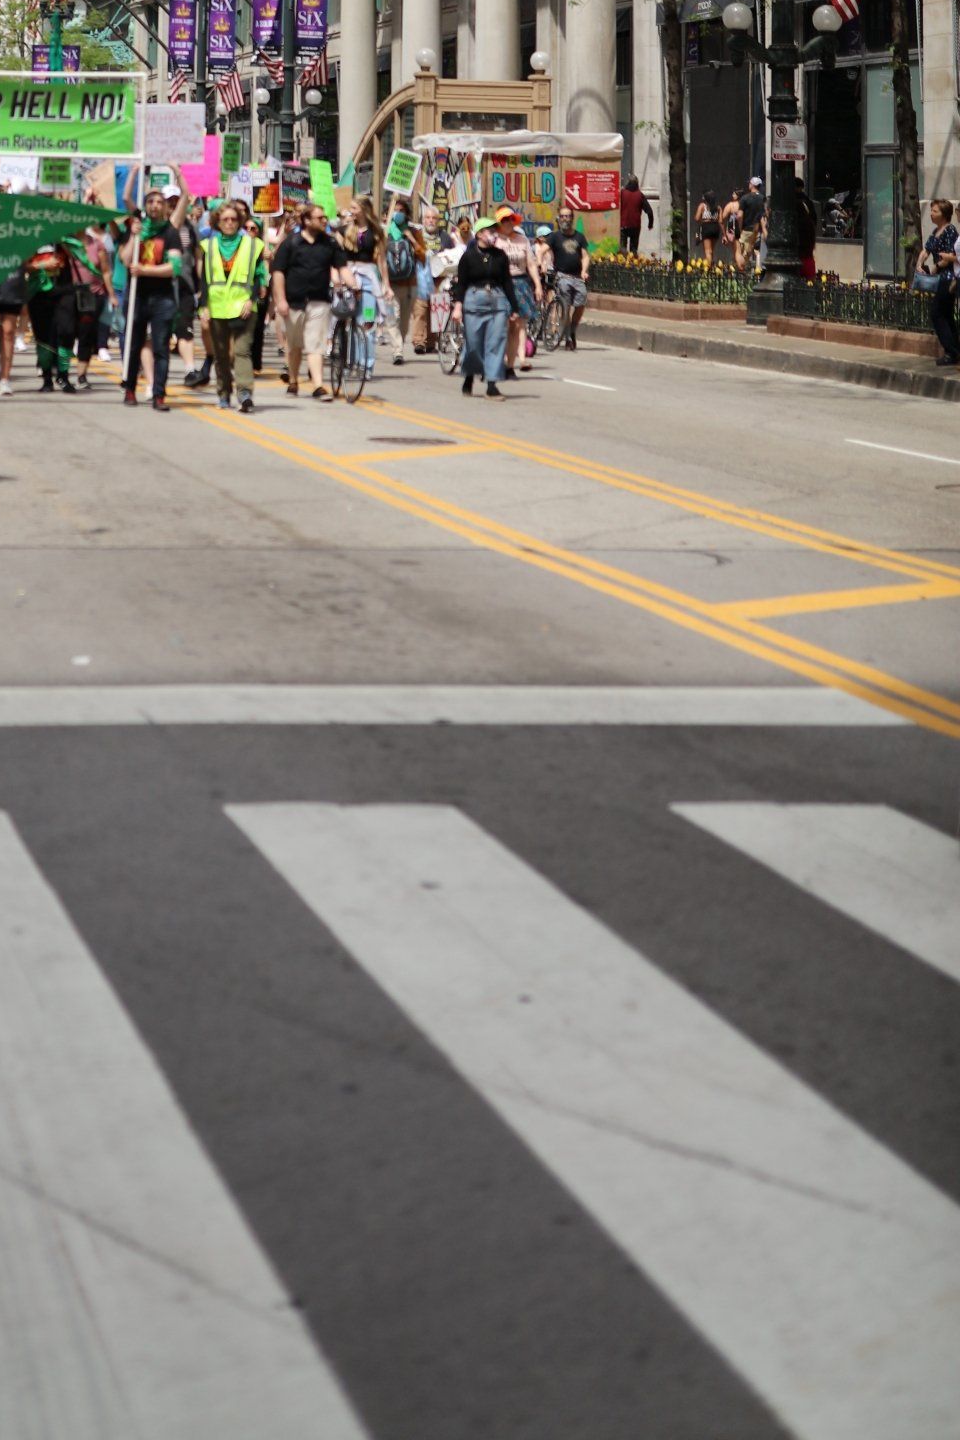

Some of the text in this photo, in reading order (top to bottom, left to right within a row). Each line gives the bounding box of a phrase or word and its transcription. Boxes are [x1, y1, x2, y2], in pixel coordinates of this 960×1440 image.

[9, 90, 72, 119] HELL
[80, 92, 125, 122] NO!
[13, 134, 78, 150] Rights.org
[493, 172, 556, 203] BUILD
